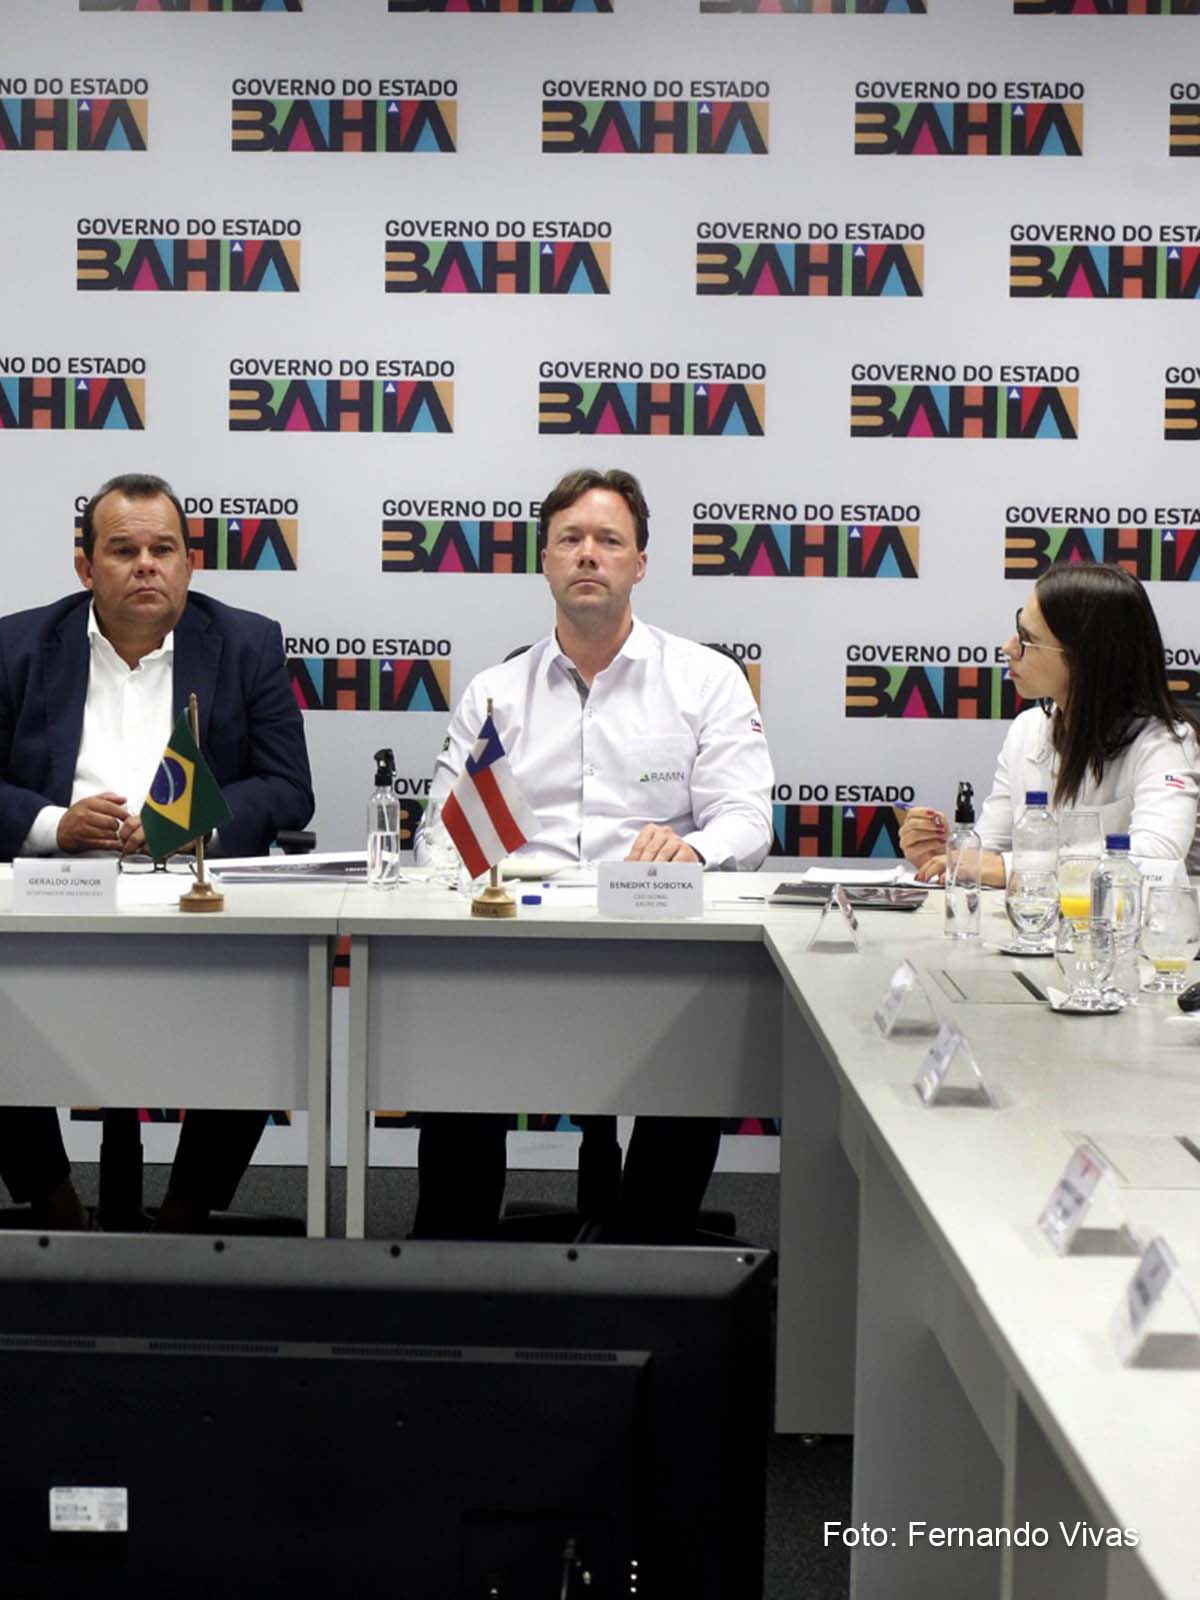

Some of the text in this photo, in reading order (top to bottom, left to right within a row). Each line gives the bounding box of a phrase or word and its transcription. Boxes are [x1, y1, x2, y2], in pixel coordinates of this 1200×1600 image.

[34, 77, 64, 95] DO
[70, 78, 149, 96] ESTADO
[231, 78, 458, 97] GOVERNO DO ESTADO
[542, 79, 770, 98] GOVERNO DO ESTADO
[855, 81, 1085, 99] GOVERNO DO ESTADO
[232, 99, 456, 153] BAHIA
[542, 101, 768, 154] BAHIA
[855, 102, 1083, 156] BAHIA
[76, 217, 302, 236] GOVERNO DO ESTADO
[385, 219, 612, 238] GOVERNO DO ESTADO
[696, 221, 925, 240] GOVERNO DO ESTADO
[1010, 224, 1116, 242] GOVERNO
[1122, 224, 1153, 242] DO
[77, 239, 300, 292] BAHIA
[385, 241, 610, 294] BAHIA
[697, 243, 923, 297] BAHIA
[1010, 245, 1200, 299] BAHI
[31, 356, 62, 374] DO
[67, 357, 146, 375] ESTADO
[229, 358, 455, 377] GOVERNO DO ESTADO
[539, 361, 767, 380] GOVERNO DO ESTADO
[851, 363, 1080, 383] GOVERNO DO ESTADO
[229, 379, 453, 433] BAHIA
[539, 382, 765, 436] BAHIA
[851, 385, 1078, 439] BAHIA
[183, 497, 299, 515] DO ESTADO
[382, 499, 486, 517] GOVERNO
[492, 500, 523, 518] DO
[692, 502, 921, 522] GOVERNO DO ESTADO
[1005, 506, 1200, 525] GOVERNO DO ESTA
[189, 517, 298, 571] HIA
[382, 520, 540, 574] BAH
[693, 524, 919, 577] BAHIA
[336, 637, 366, 655] DO
[372, 638, 452, 656] ESTADO
[846, 644, 951, 662] GOVERNO
[957, 646, 988, 664] DO
[286, 657, 451, 712] AHIA
[845, 664, 1016, 720] BAHI
[798, 784, 829, 802] DO
[835, 785, 915, 803] ESTADO
